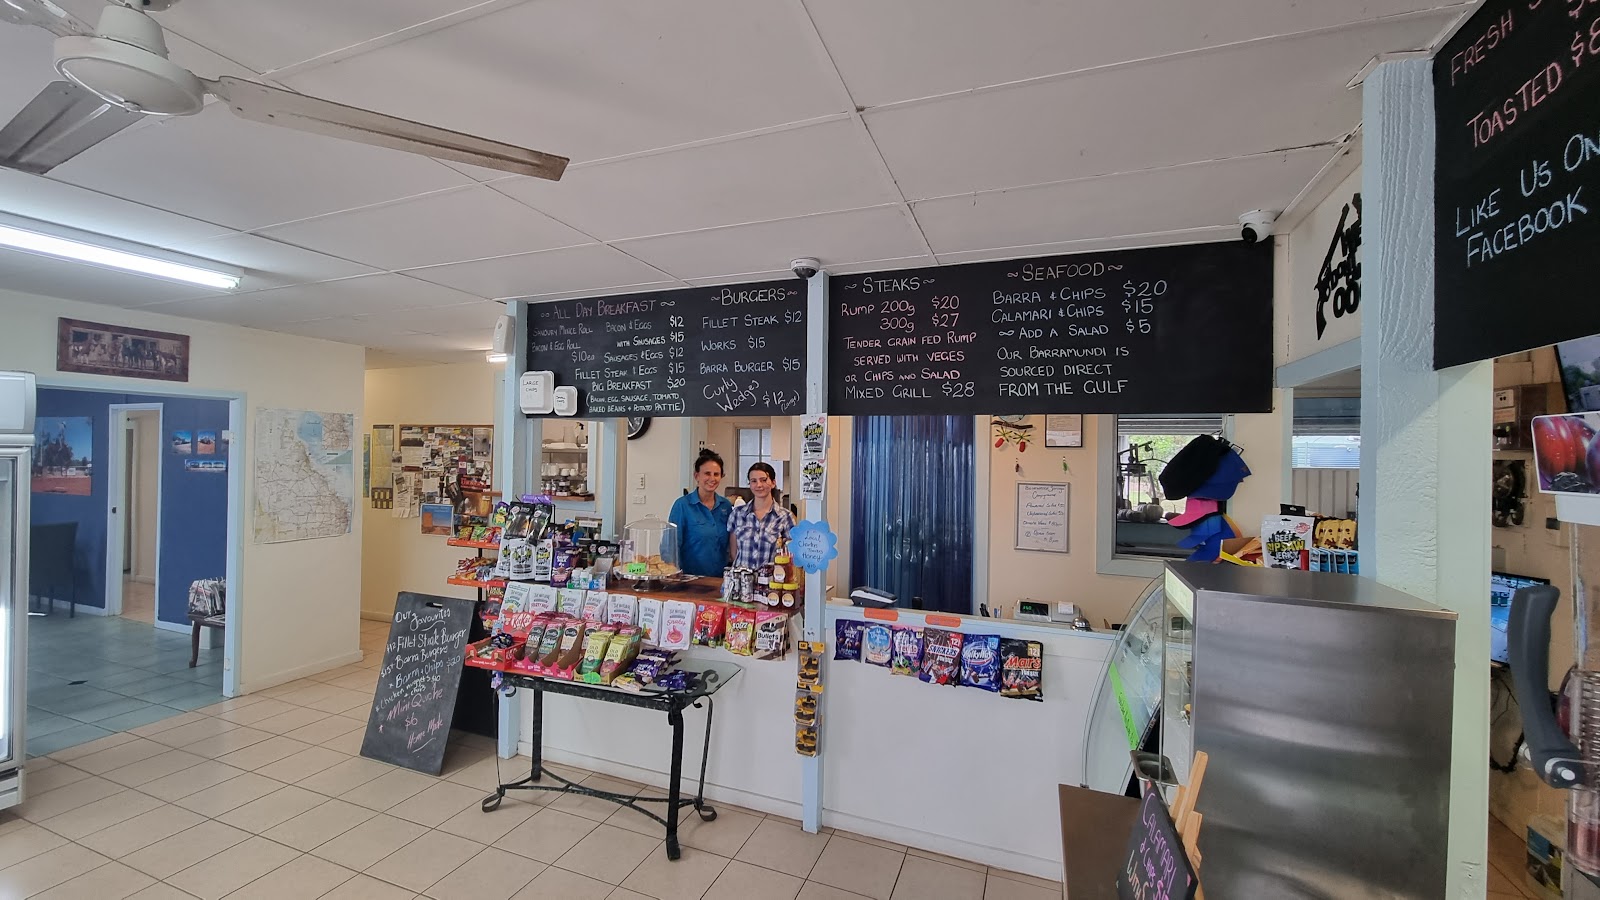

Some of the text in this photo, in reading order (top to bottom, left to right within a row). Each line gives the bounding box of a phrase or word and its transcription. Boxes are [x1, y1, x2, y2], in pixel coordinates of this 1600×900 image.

[1452, 9, 1513, 86] FRESH
[1467, 62, 1562, 147] TOASTED
[1456, 188, 1500, 238] LIKE
[1521, 160, 1552, 197] US
[1467, 186, 1588, 268] FACEBOOK
[1022, 262, 1105, 281] SEAFOOD
[862, 277, 920, 293] STEAKS
[993, 290, 1041, 305] BARRA
[1060, 287, 1106, 301] CHIPS
[1123, 280, 1168, 297] $20
[721, 288, 786, 306] BURGERS
[880, 300, 916, 316] 200g
[931, 295, 960, 310] $20
[552, 299, 656, 319] ALL DAY BREAKFAST
[991, 309, 1052, 323] CALAMARI
[1066, 304, 1105, 318] CHIPS
[1121, 299, 1154, 314] $15
[606, 322, 627, 333] BACON
[634, 319, 651, 330] EGGS
[670, 315, 684, 327] $12
[702, 309, 802, 329] FILLET STEAK $12
[879, 312, 960, 333] 300g $27
[579, 323, 593, 334] ROLL
[1018, 319, 1151, 340] ADD A SALAD $5
[554, 341, 565, 351] EGG
[567, 339, 581, 349] ROLL
[632, 336, 666, 347] SAUSAGES
[670, 331, 684, 343] $15
[701, 335, 766, 351] WORKS $15
[843, 336, 882, 349] TENDER
[887, 337, 917, 347] GRAIN
[921, 335, 941, 345] FED
[604, 352, 638, 364] SAUSAGES
[645, 350, 664, 360] EGGS
[669, 347, 684, 359] $12
[854, 351, 965, 366] SERVED WITH VEGES
[996, 346, 1129, 360] OUR BARRAMUNDI IS
[575, 368, 601, 380] FILLET
[604, 367, 628, 379] STEAK
[639, 365, 658, 375] EGGS
[668, 362, 685, 374] $15
[700, 357, 800, 375] BARRA BURGER $15
[864, 370, 894, 382] CHIPS
[921, 368, 961, 380] SALAD
[1000, 364, 1113, 378] SOURCED DIRECT
[592, 376, 686, 391] BIG BREAKFAST $20
[703, 377, 738, 400] Curly
[845, 381, 975, 399] MIXED GRILL $28
[999, 380, 1128, 397] FROM THE GULF
[716, 380, 759, 412] Wedges
[633, 404, 652, 412] POTATO
[805, 530, 821, 542] Local
[1274, 534, 1293, 542] BEEF
[802, 552, 823, 562] Honey
[395, 610, 411, 623] Our
[397, 633, 416, 653] Fillet
[441, 627, 467, 649] Burger
[421, 645, 448, 663] Burgers
[928, 645, 959, 657] SNICKERS
[1004, 656, 1041, 669] Mars
